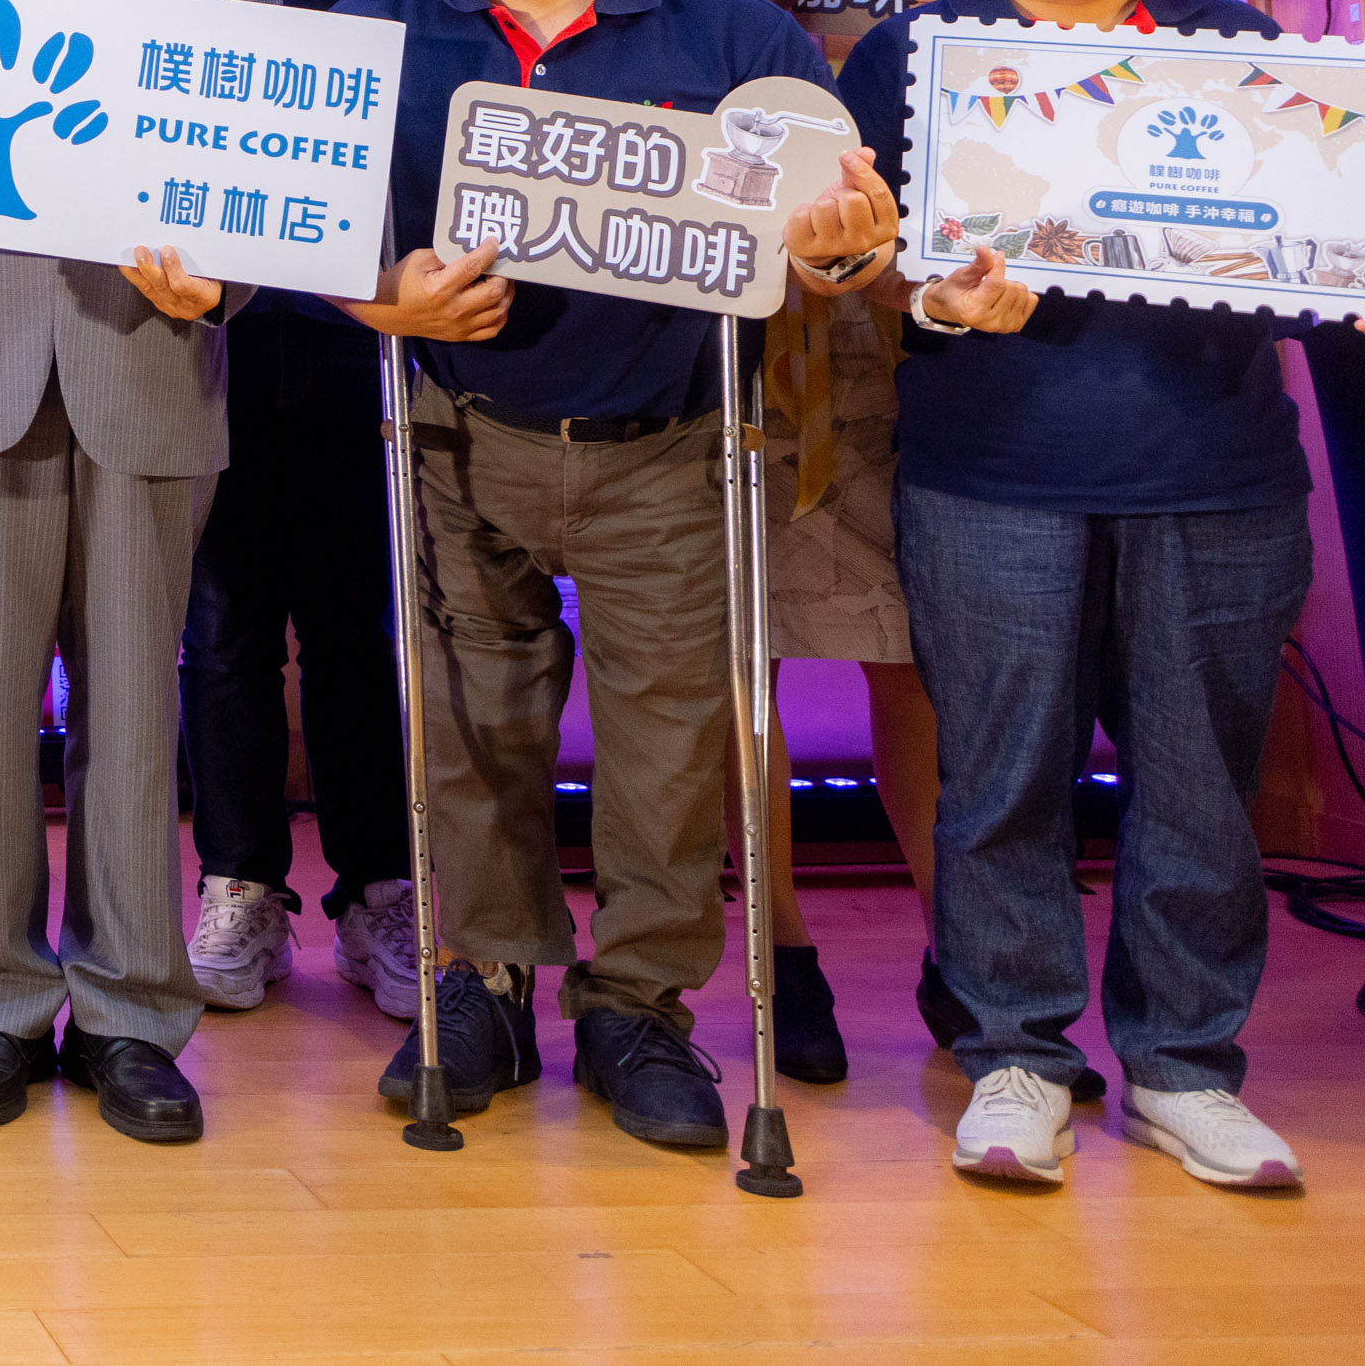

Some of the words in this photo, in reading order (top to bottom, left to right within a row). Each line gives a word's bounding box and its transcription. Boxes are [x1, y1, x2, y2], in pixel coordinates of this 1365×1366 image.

[137, 39, 381, 120] 樸樹咖啡
[135, 115, 228, 151] PURE
[240, 130, 370, 170] COFFEE
[463, 106, 679, 192] 最好的
[1149, 182, 1178, 191] PURE
[1180, 184, 1220, 194] COFFEE
[1184, 204, 1255, 223] 手沖幸福
[455, 189, 752, 294] 職人咖啡
